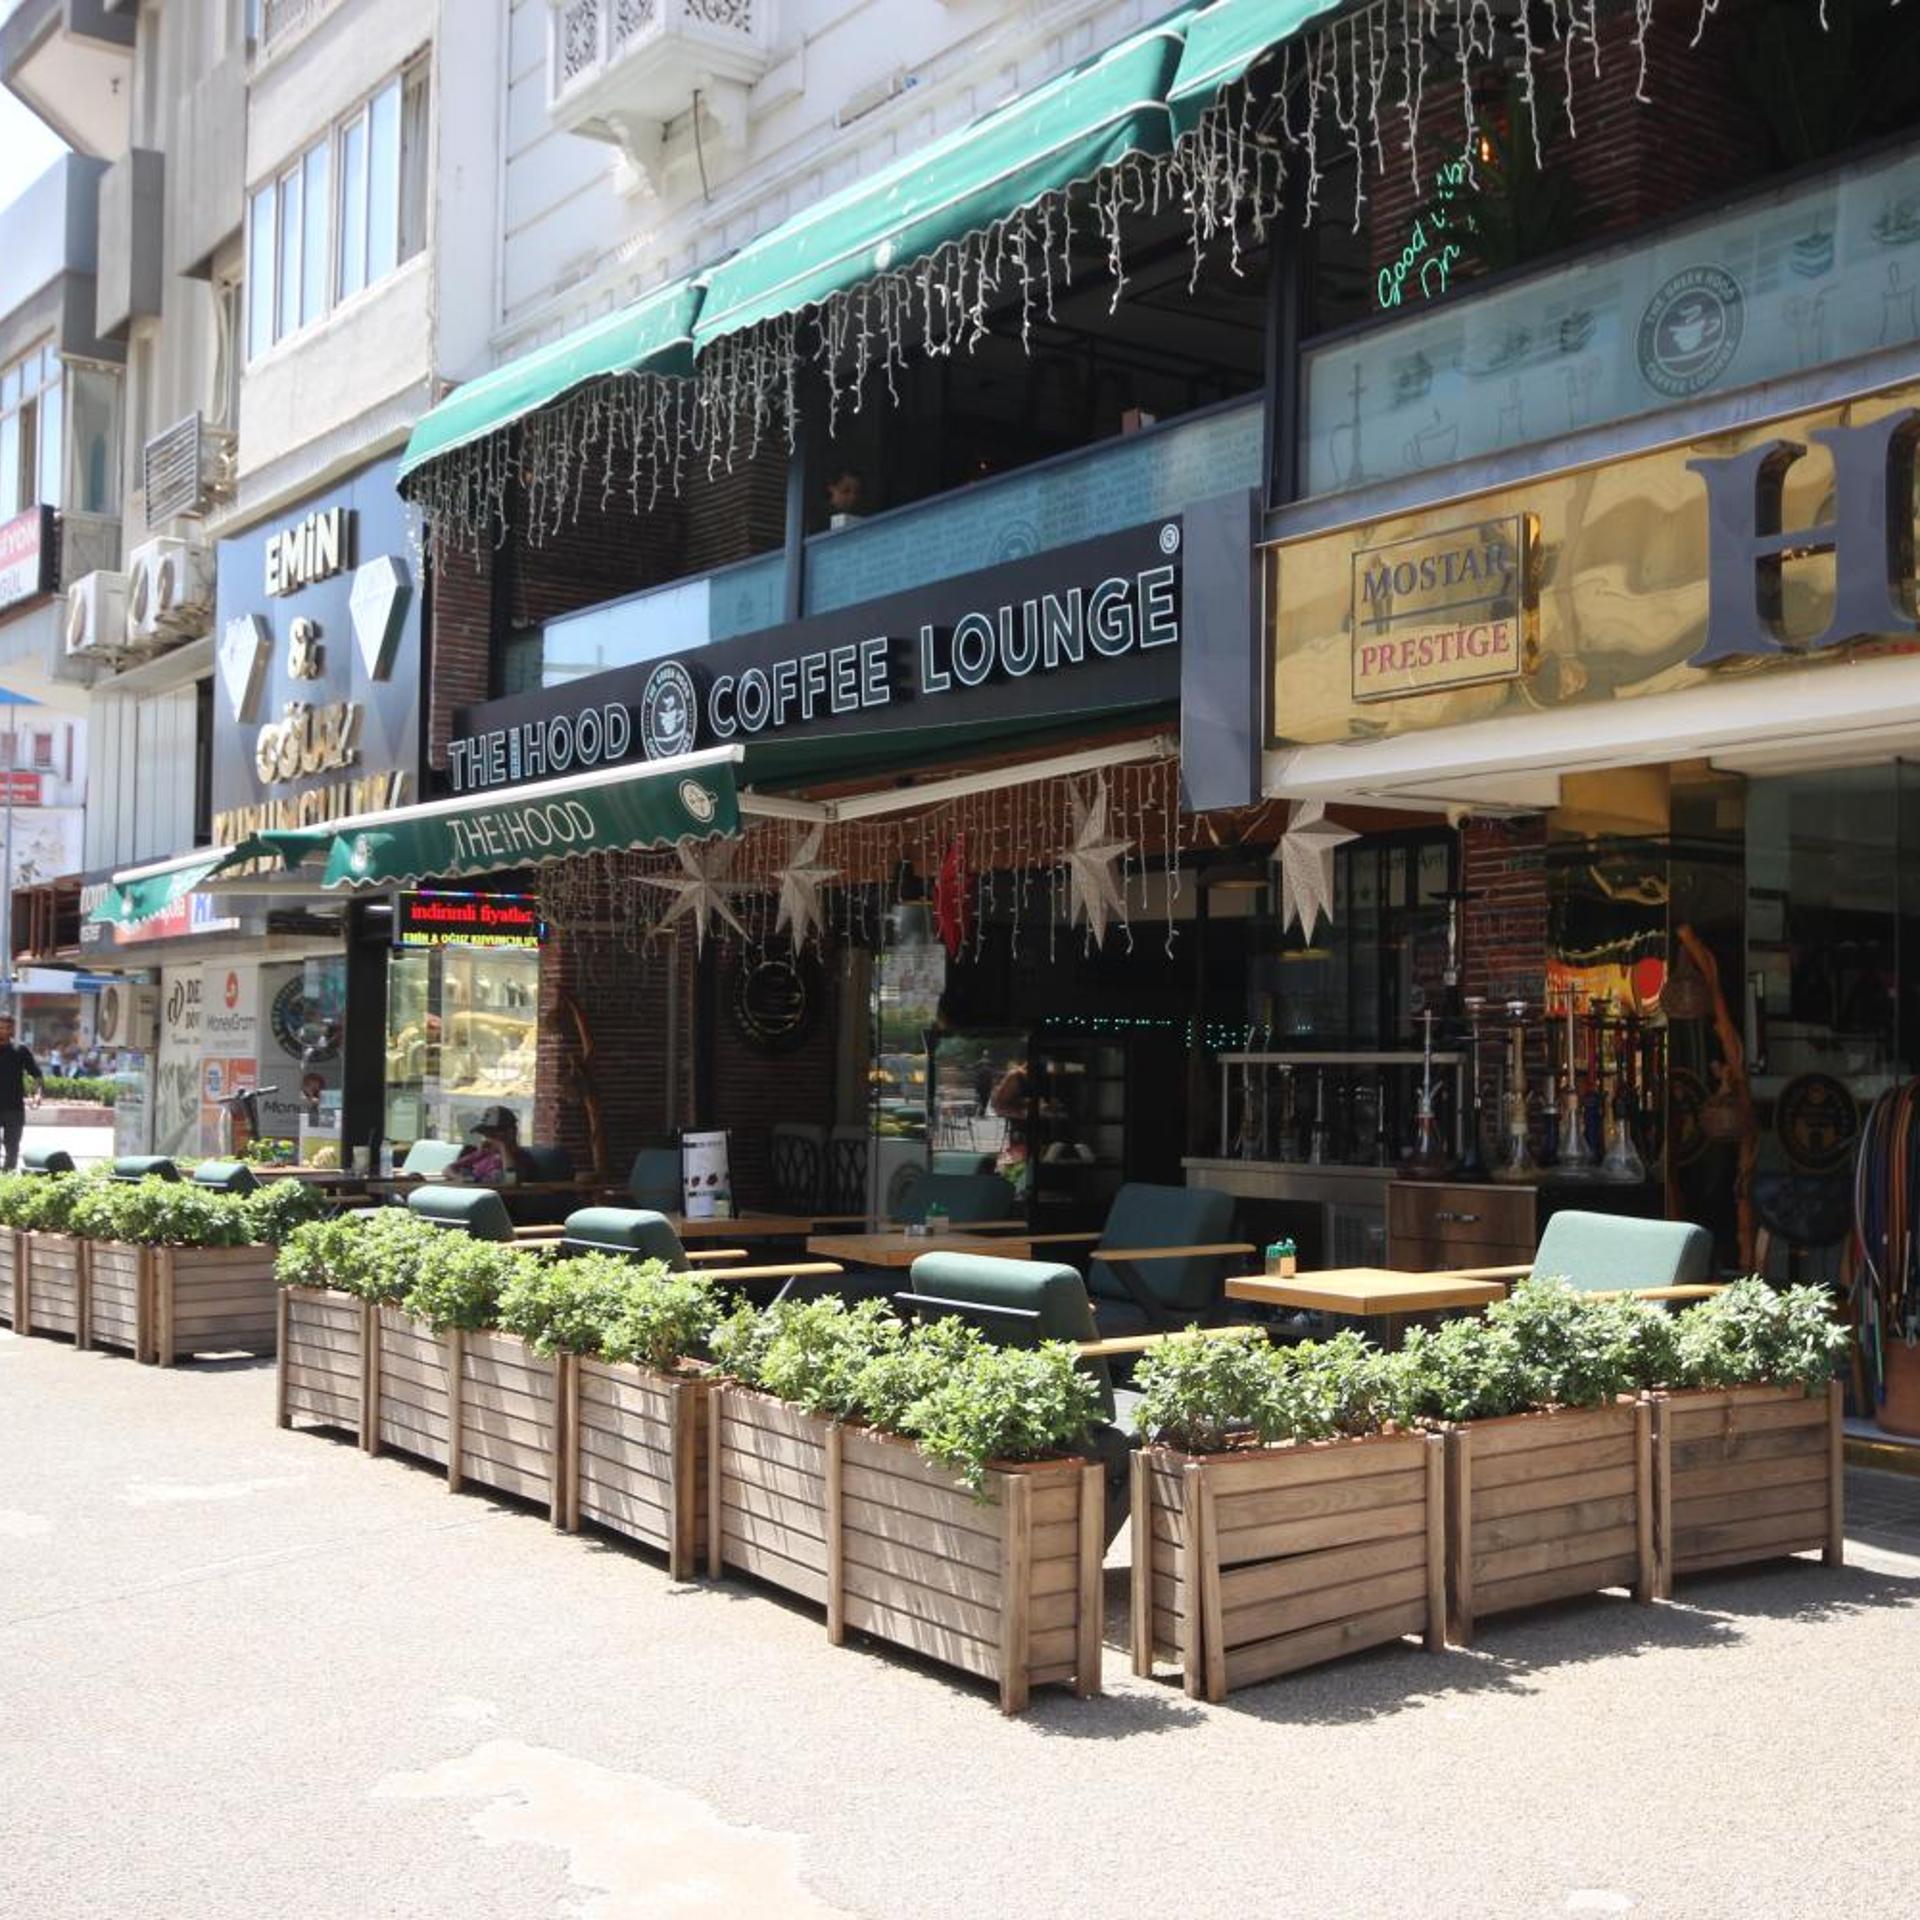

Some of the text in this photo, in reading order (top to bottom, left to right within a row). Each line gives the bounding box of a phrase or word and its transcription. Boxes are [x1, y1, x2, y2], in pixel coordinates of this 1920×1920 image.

[1378, 219, 1427, 308] Good
[1645, 298, 1663, 323] THE
[1705, 272, 1737, 301] HOOD
[1363, 541, 1508, 603] MOSTAR
[288, 617, 318, 680] &
[448, 730, 507, 791] THE
[524, 702, 631, 777] HOOD
[708, 636, 891, 739] COFFEE
[920, 564, 1179, 696] LOUNGE
[446, 815, 505, 859] THE
[502, 801, 595, 851] HOOD
